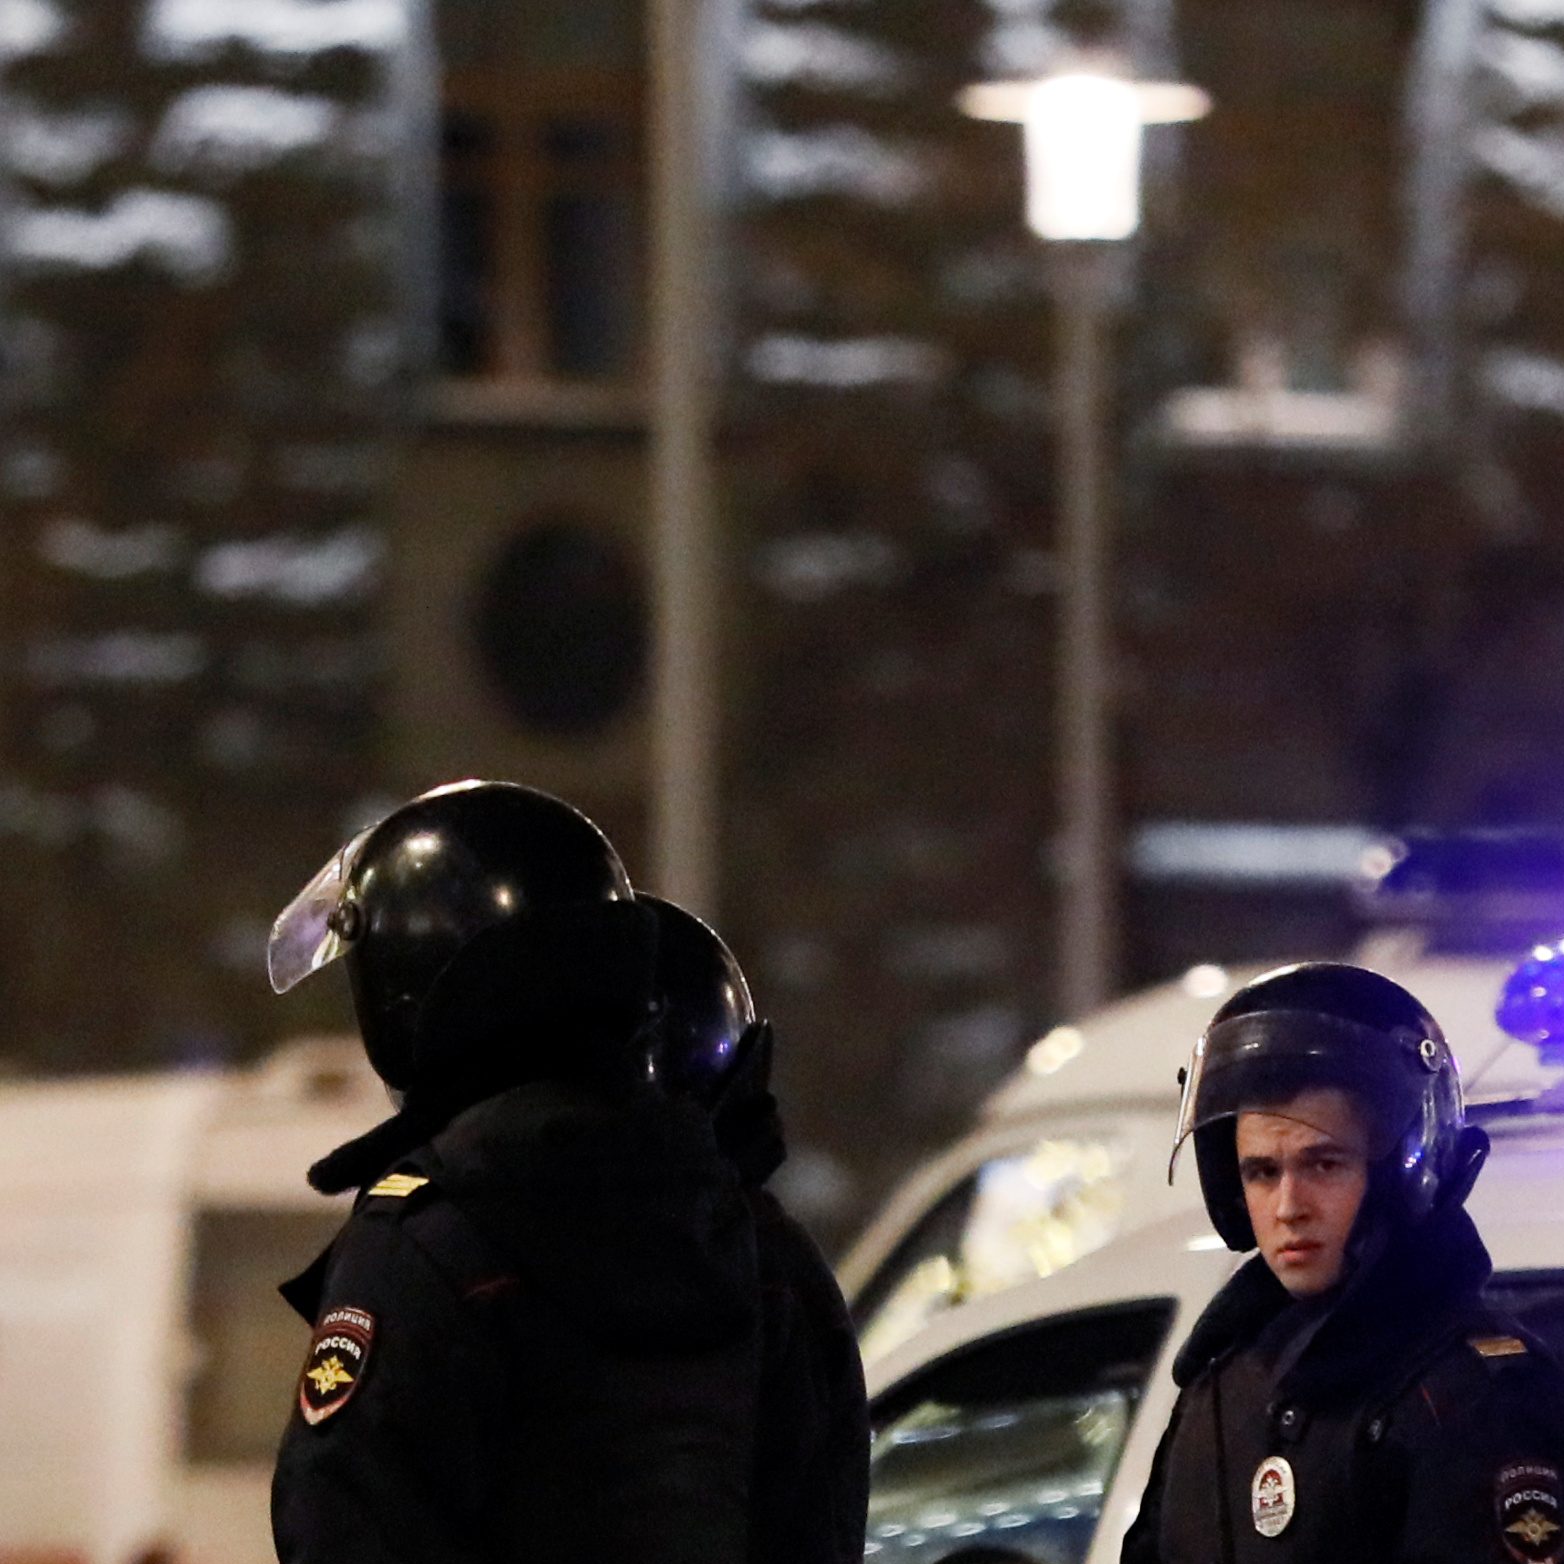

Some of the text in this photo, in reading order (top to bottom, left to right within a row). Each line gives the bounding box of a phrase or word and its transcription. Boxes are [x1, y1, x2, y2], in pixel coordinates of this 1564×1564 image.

[323, 1310, 371, 1331] ПОЛИЦИЯ
[314, 1336, 362, 1360] РОССИЯ
[1504, 1489, 1558, 1509] РОССИЯ
